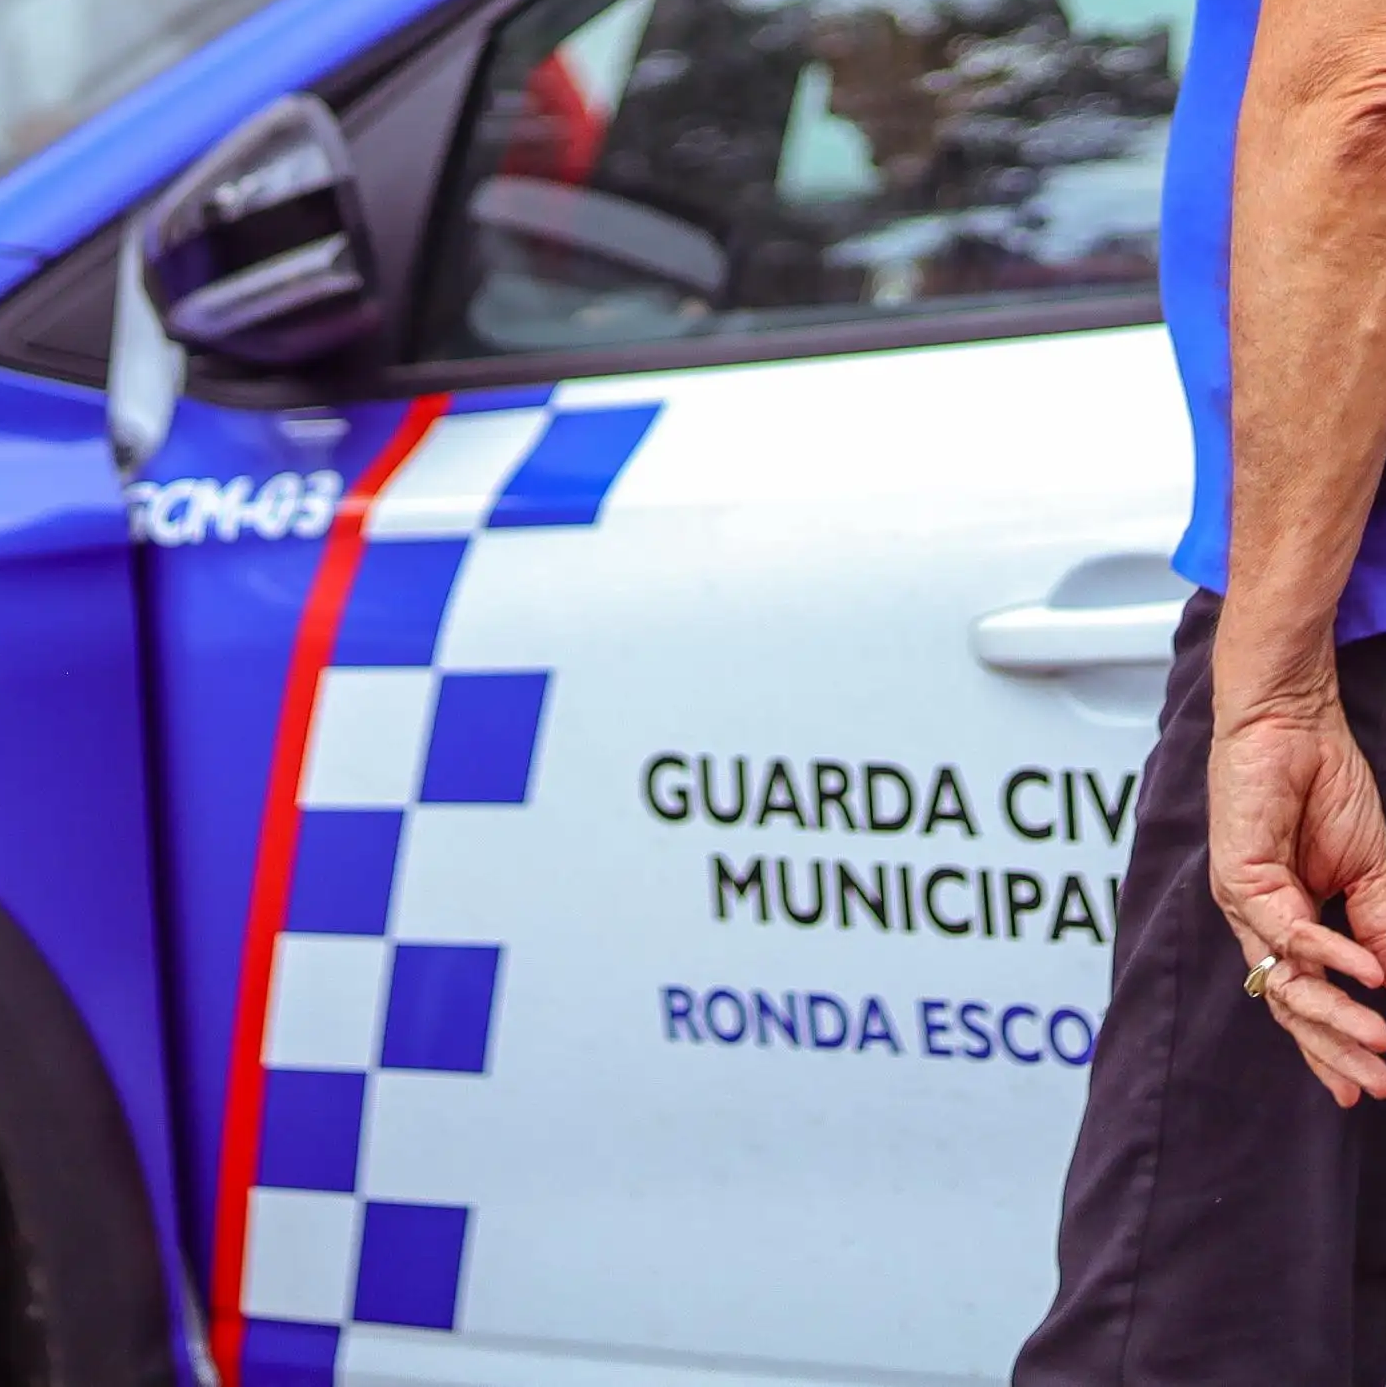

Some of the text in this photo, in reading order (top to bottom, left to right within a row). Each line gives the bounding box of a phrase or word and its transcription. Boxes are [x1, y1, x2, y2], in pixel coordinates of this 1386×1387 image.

[645, 755, 1137, 842] GUARDA CIV
[661, 986, 1097, 1068] RONDA ESCO
